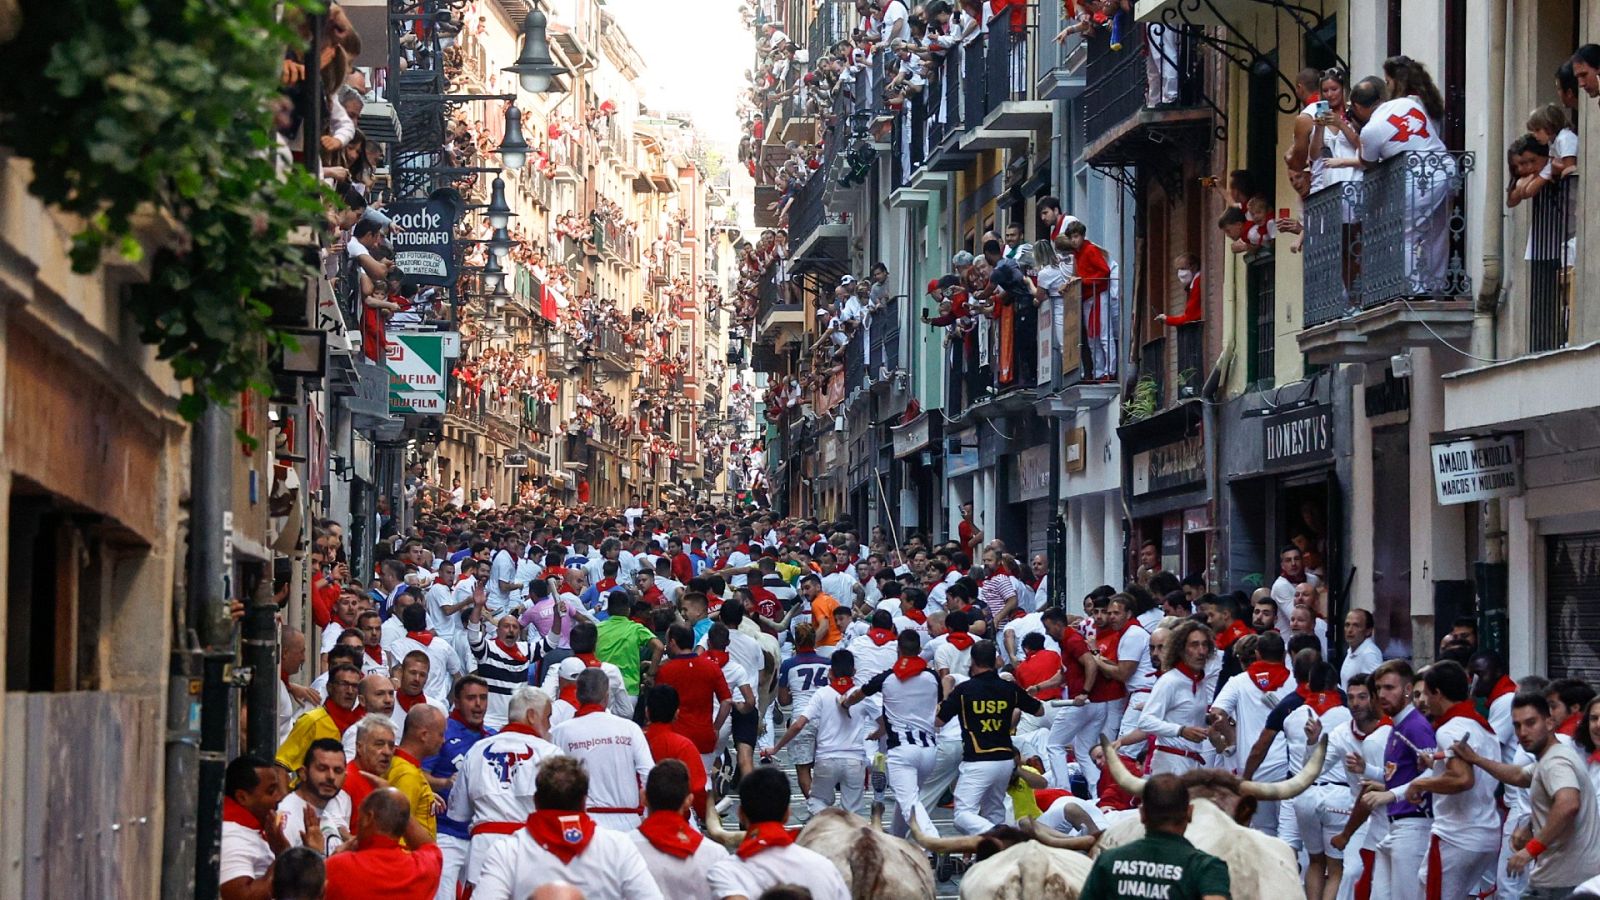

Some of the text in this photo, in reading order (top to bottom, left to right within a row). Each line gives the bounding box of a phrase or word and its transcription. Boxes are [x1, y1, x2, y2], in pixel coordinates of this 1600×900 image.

[390, 231, 449, 245] FOTOGRAFO
[1439, 445, 1512, 474] AMADO MENDOZA
[1441, 478, 1470, 496] MARCOS
[1471, 477, 1477, 492] Y
[973, 700, 1008, 714] USP
[980, 719, 1003, 732] XV
[615, 736, 632, 746] 2022
[1112, 860, 1183, 880] PASTORES
[1118, 880, 1171, 900] UNAIAK
